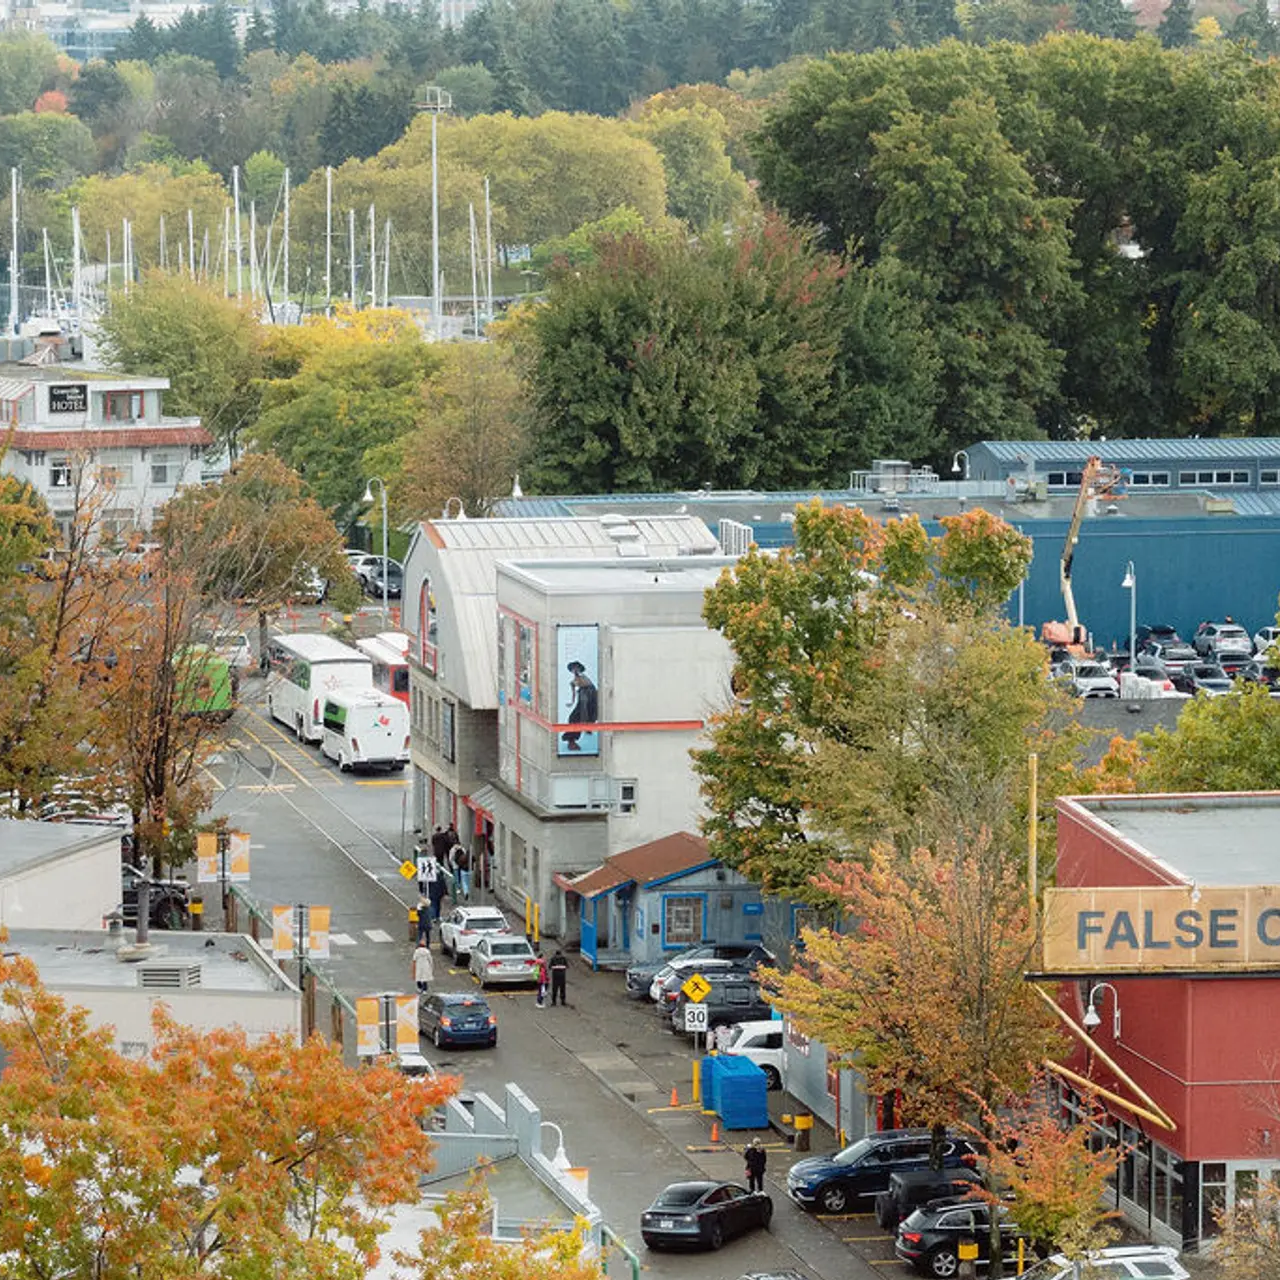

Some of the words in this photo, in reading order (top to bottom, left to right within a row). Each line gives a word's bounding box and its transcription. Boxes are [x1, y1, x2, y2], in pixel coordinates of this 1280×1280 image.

[52, 401, 86, 410] HOTEL
[1077, 908, 1239, 950] FALSE
[687, 1010, 705, 1023] 30
